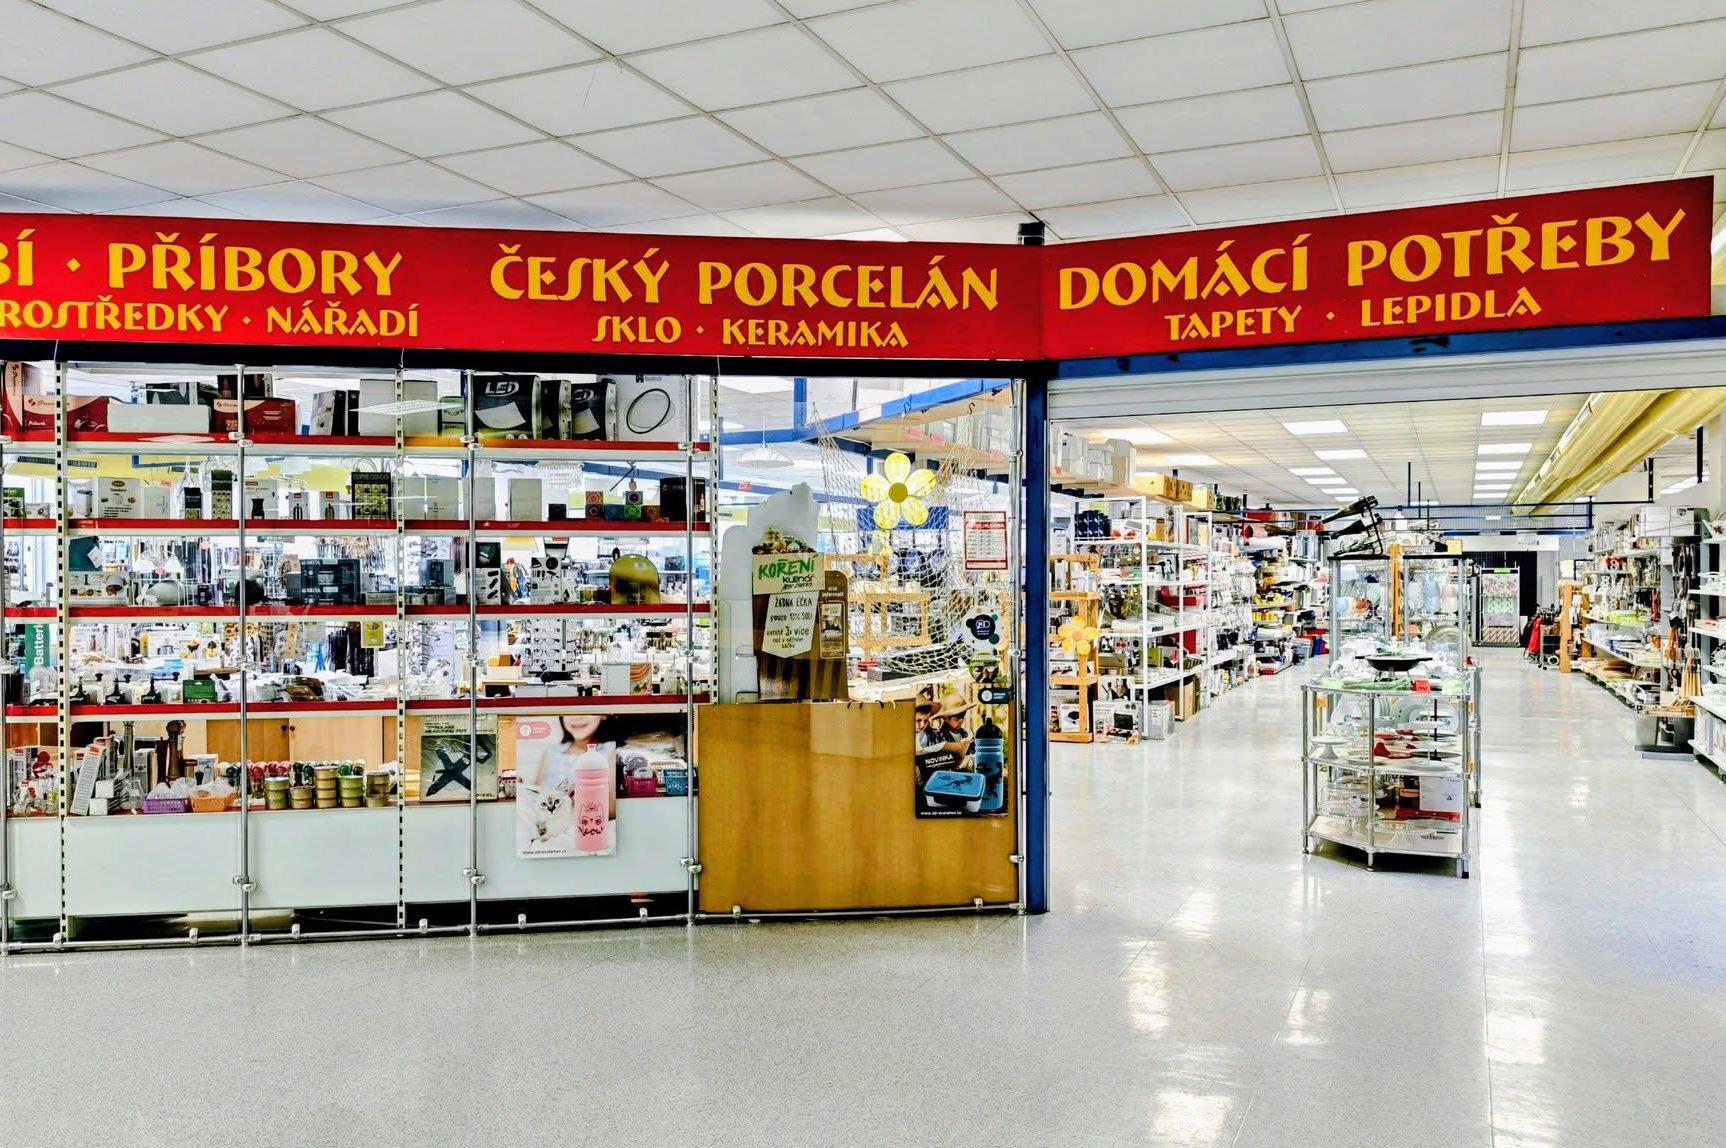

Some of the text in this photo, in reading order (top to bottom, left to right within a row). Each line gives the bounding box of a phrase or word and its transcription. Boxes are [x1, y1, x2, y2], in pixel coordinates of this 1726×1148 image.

[108, 231, 403, 296] PŘÍBORY
[490, 243, 999, 311] ČESKÝ PORCELÁN
[1059, 208, 1686, 311] DOMÁCÍ POTŘEBY
[266, 299, 420, 338] NÁŘADÍ
[593, 315, 910, 349] SKLO KERAMIKA
[1164, 286, 1543, 341] TAPETY LEPIDLA
[485, 382, 519, 396] LED
[758, 554, 818, 580] KOŘENÍ
[925, 754, 954, 765] NOVINKA
